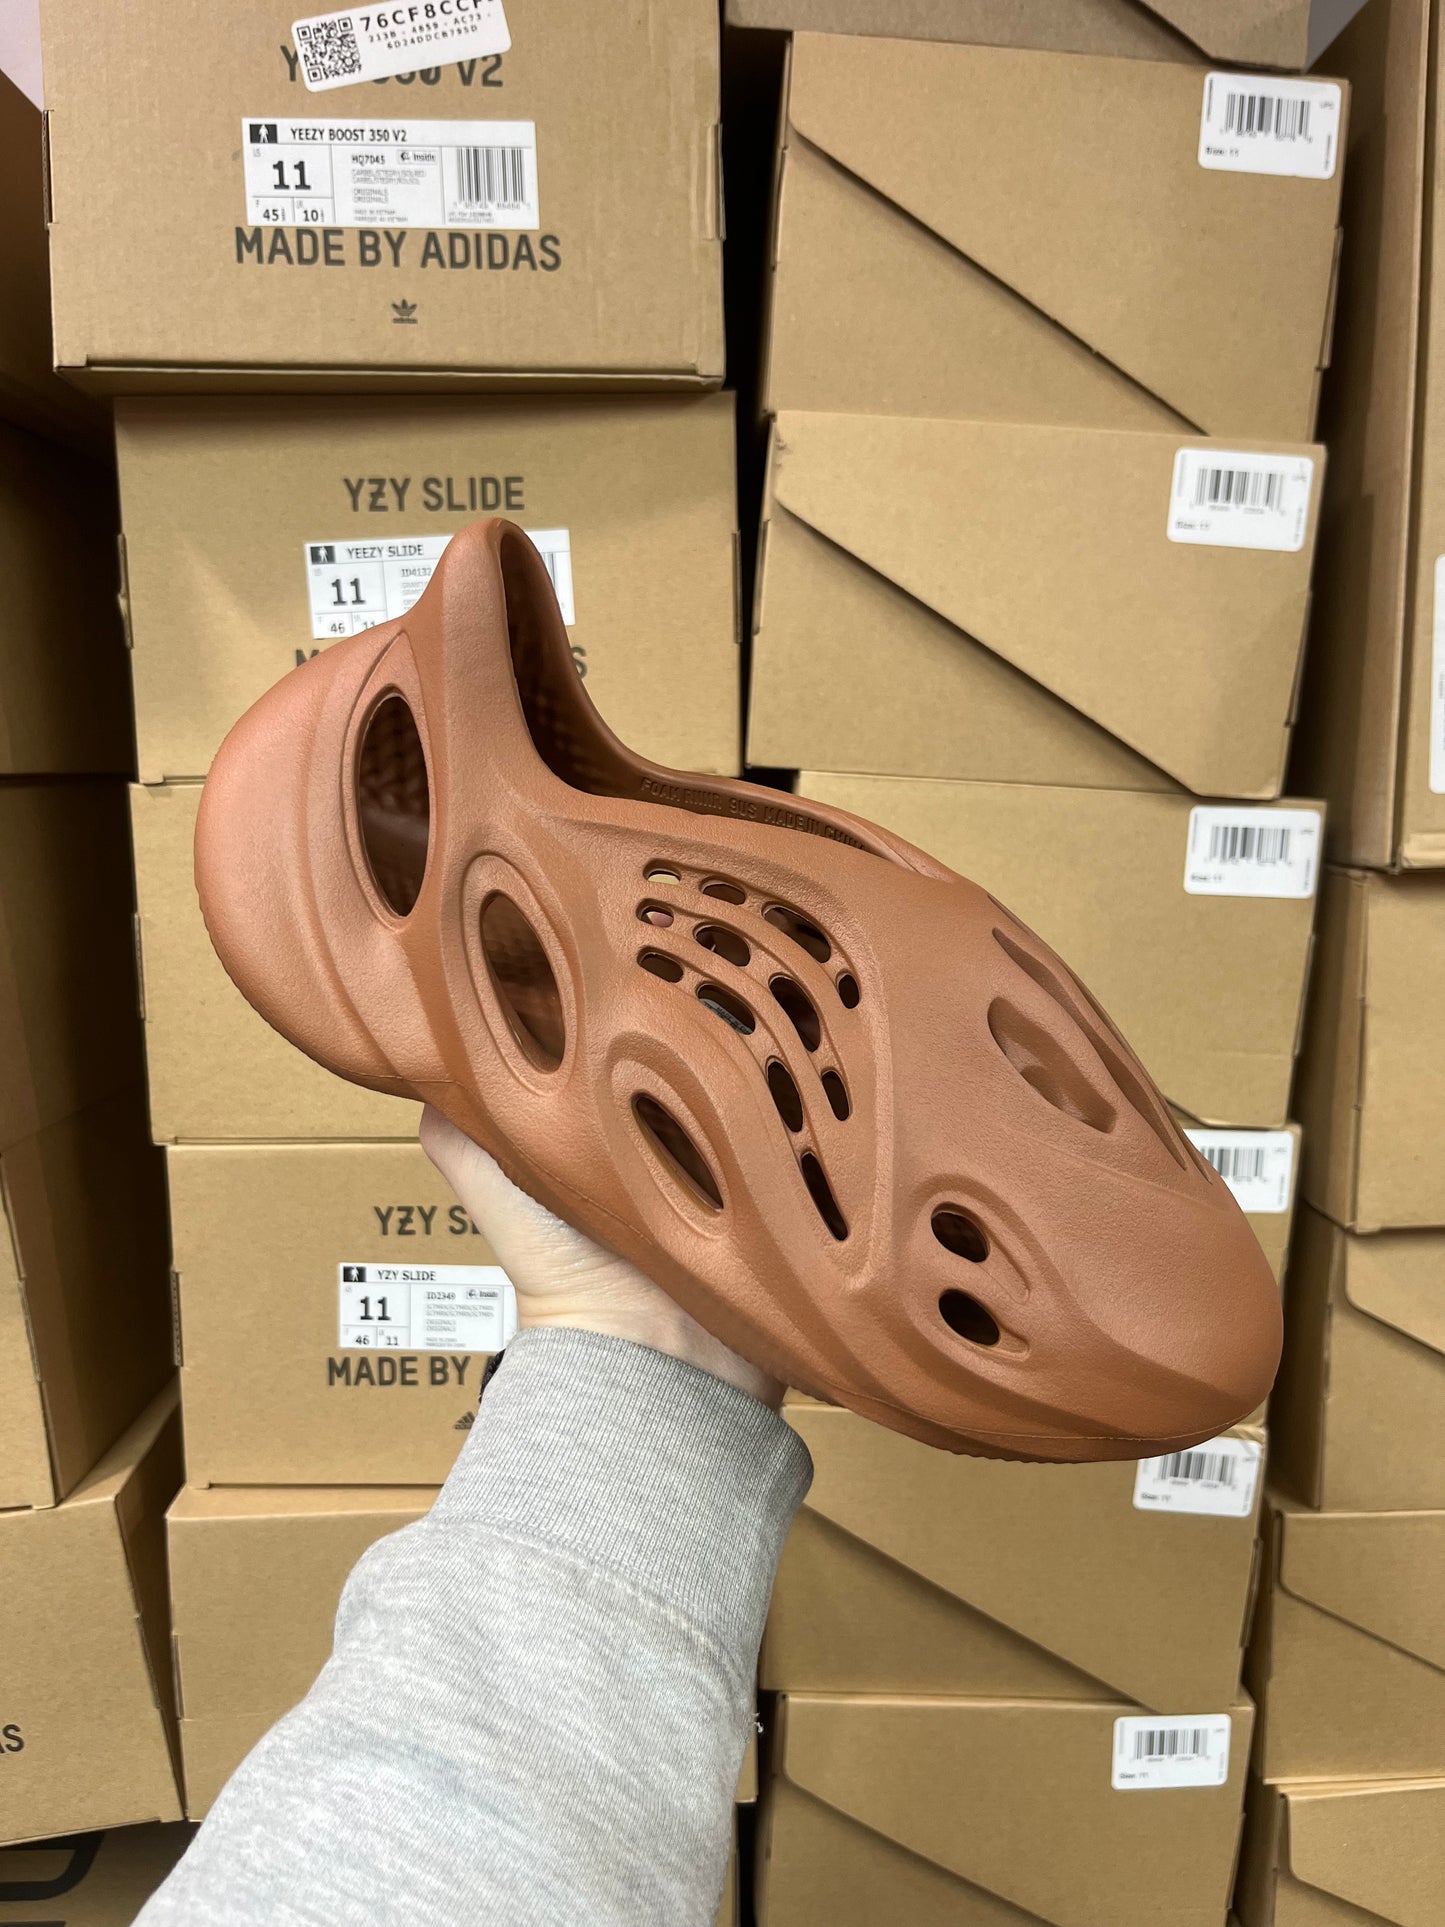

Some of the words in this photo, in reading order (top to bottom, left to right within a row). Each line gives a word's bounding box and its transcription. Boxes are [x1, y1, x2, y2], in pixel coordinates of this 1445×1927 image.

[457, 54, 503, 87] V2
[290, 128, 324, 140] YEEZY
[329, 129, 364, 141] BOOST
[369, 129, 390, 142] 350
[393, 129, 407, 142] V2
[272, 160, 311, 190] 11
[235, 226, 345, 267] MADE
[359, 229, 406, 267] BY
[420, 231, 561, 272] ADIDAS
[343, 477, 411, 512] YZY
[423, 476, 524, 512] SLIDE
[347, 546, 383, 558] YEEZY
[388, 544, 423, 557] SLIDE
[331, 578, 366, 606] 11
[641, 777, 680, 802] FOAM
[763, 807, 804, 831] MADE
[374, 1206, 437, 1236] YZY
[448, 1205, 480, 1235] S
[378, 1270, 398, 1280] YZY
[402, 1270, 436, 1281] SLIDE
[360, 1296, 391, 1321] 11
[355, 1336, 370, 1345] 46
[386, 1336, 399, 1346] 11
[328, 1356, 419, 1386] MADE
[430, 1356, 471, 1386] BY
